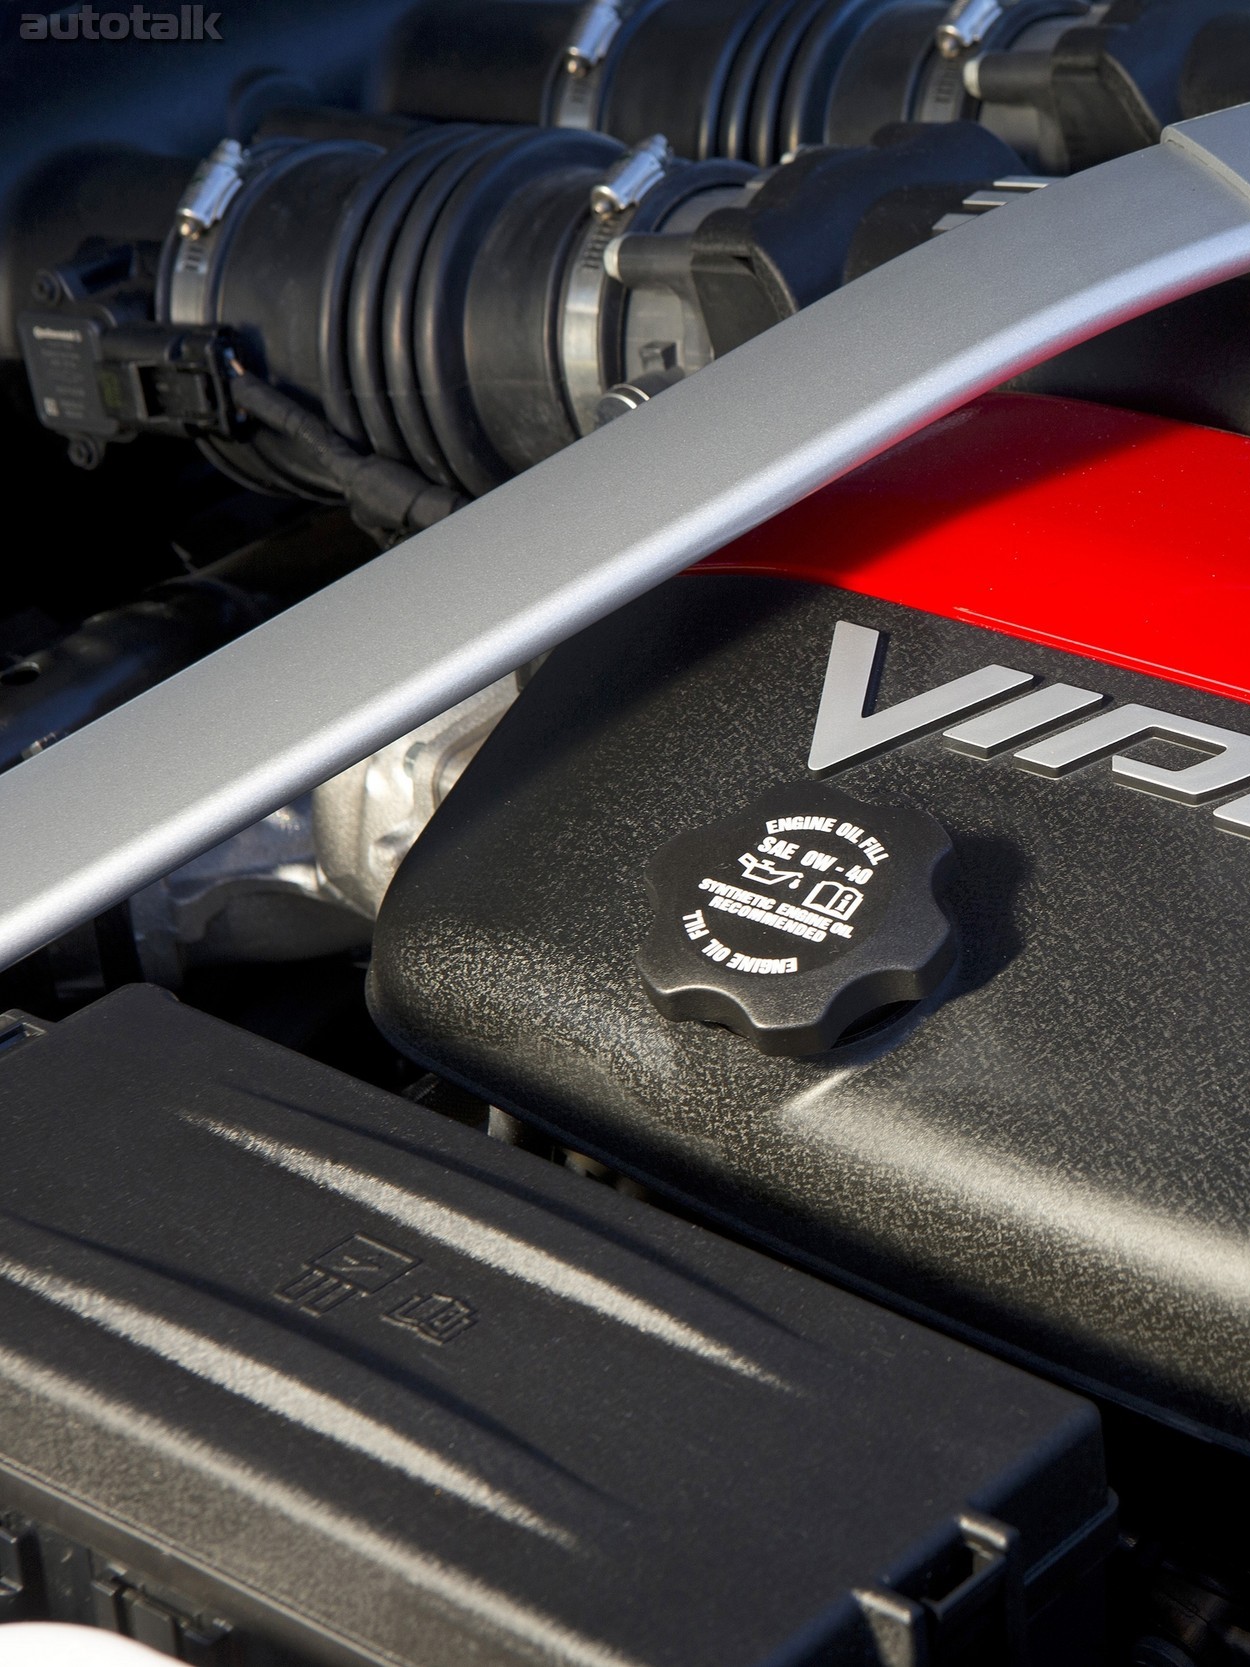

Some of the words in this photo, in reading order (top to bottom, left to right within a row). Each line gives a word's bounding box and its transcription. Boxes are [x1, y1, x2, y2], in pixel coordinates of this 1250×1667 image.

[756, 836, 801, 861] SAE
[844, 864, 874, 885] 40
[765, 815, 838, 835] ENGINE
[835, 822, 865, 845] OIL
[857, 836, 890, 866] FILL
[682, 909, 710, 941] FILL
[697, 877, 777, 911] SYNTHETIC
[775, 902, 831, 931] ENGINE
[829, 921, 855, 939] OIL
[708, 895, 828, 943] RECOMMENDED
[701, 938, 732, 962] OIL
[725, 952, 798, 975] ENGINE
